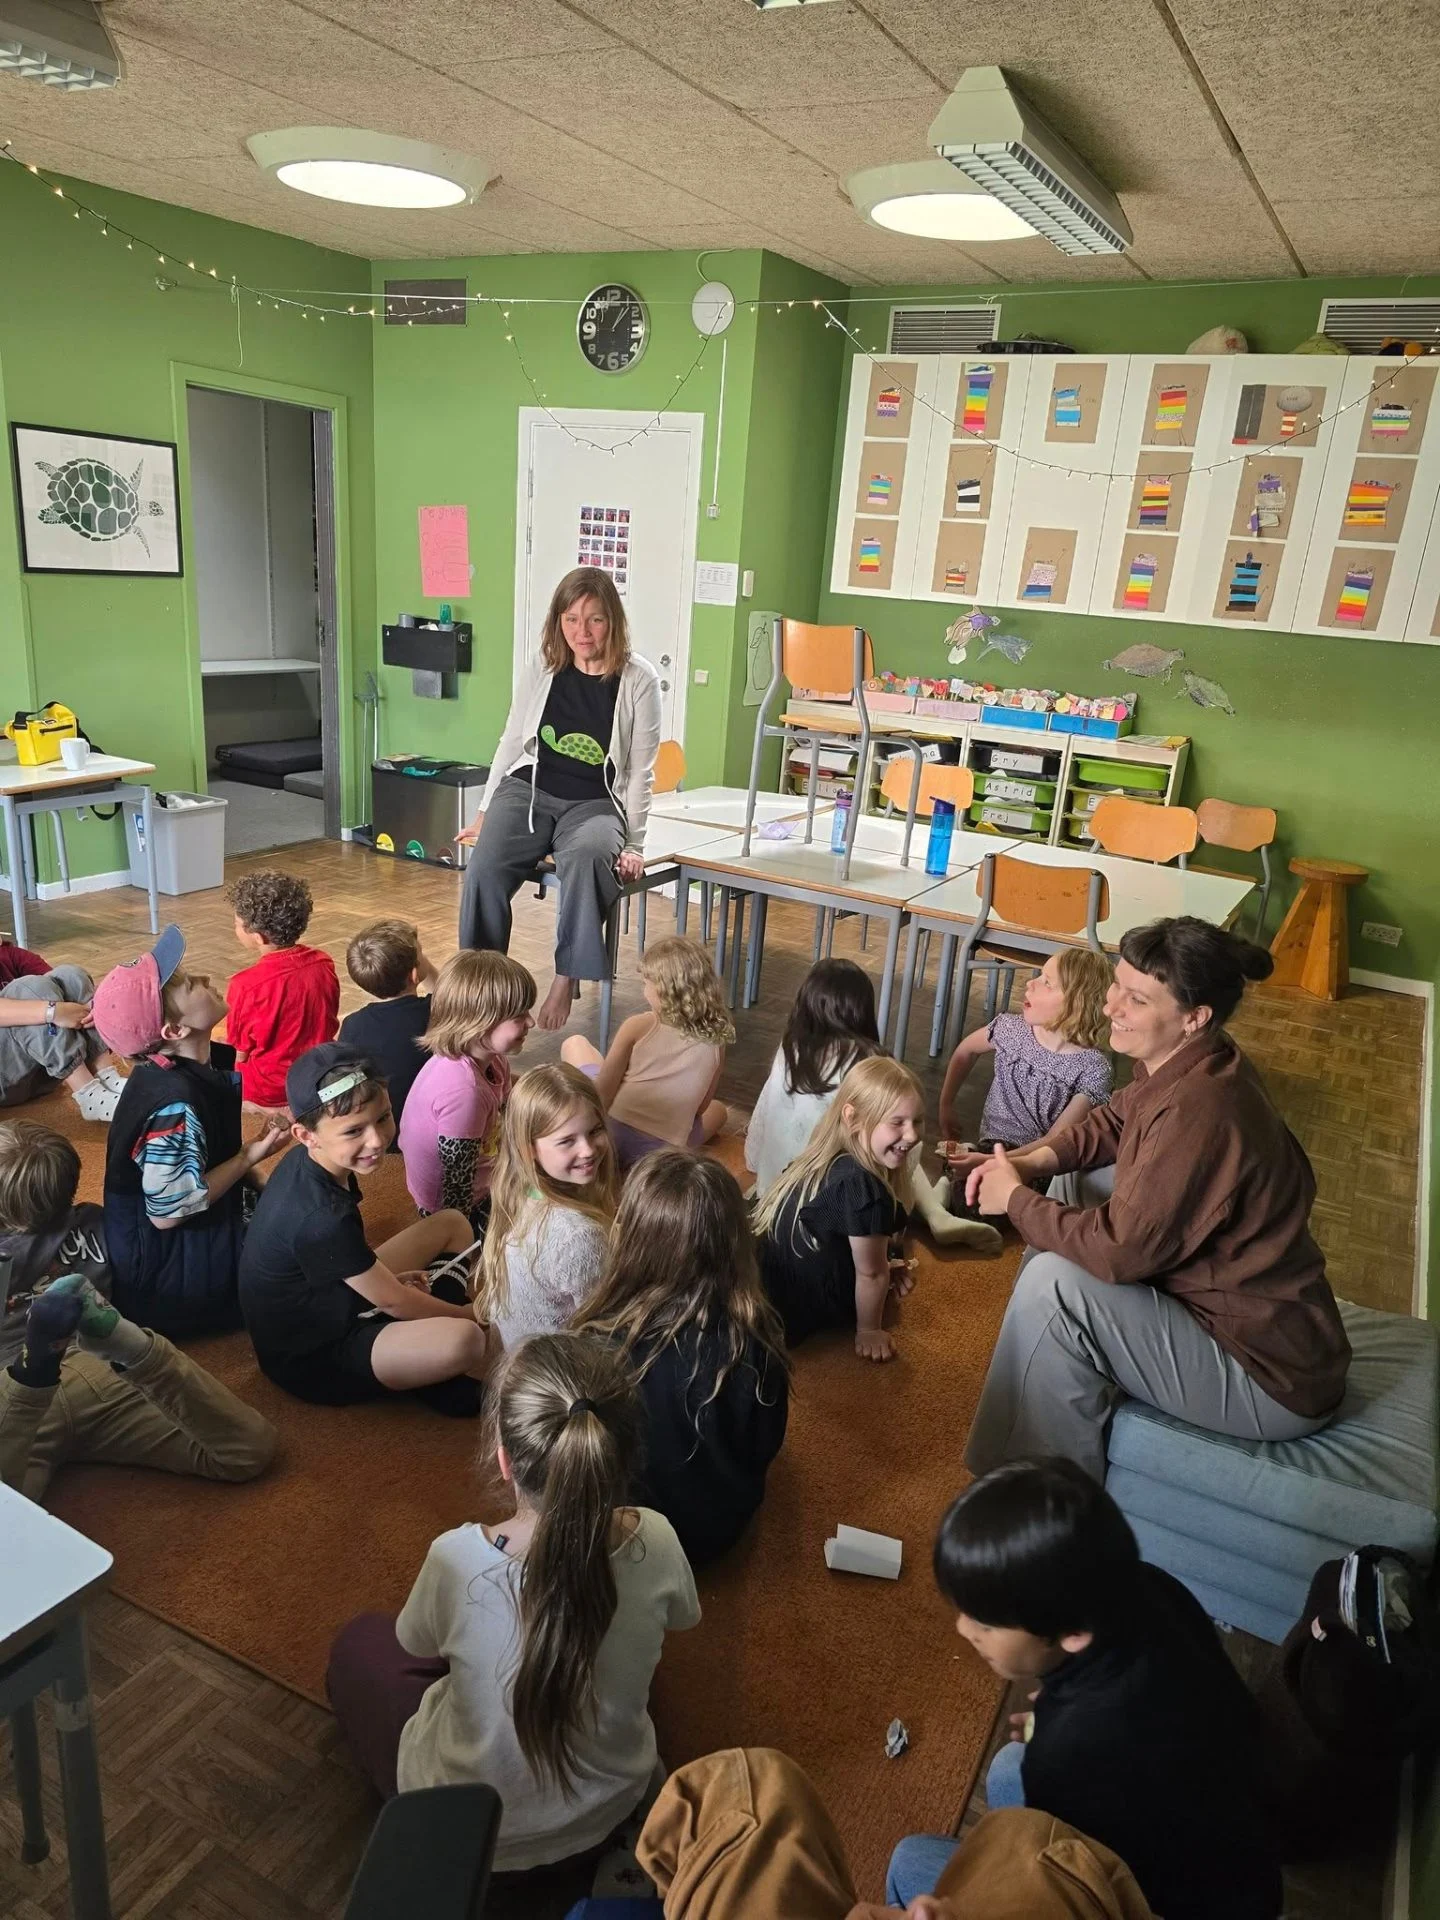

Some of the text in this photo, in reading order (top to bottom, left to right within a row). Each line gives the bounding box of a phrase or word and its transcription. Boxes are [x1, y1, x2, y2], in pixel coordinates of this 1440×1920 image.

[606, 289, 621, 307] 12
[586, 307, 597, 320] 10
[631, 306, 639, 317] 2
[582, 321, 597, 340] 9
[630, 320, 643, 339] 3
[587, 344, 596, 355] 8
[629, 342, 638, 353] 4
[597, 354, 606, 366] 7
[607, 352, 619, 370] 6
[620, 354, 629, 365] 5
[991, 754, 1020, 768] Gry
[985, 782, 1033, 797] Astrid
[982, 809, 1009, 824] Frej
